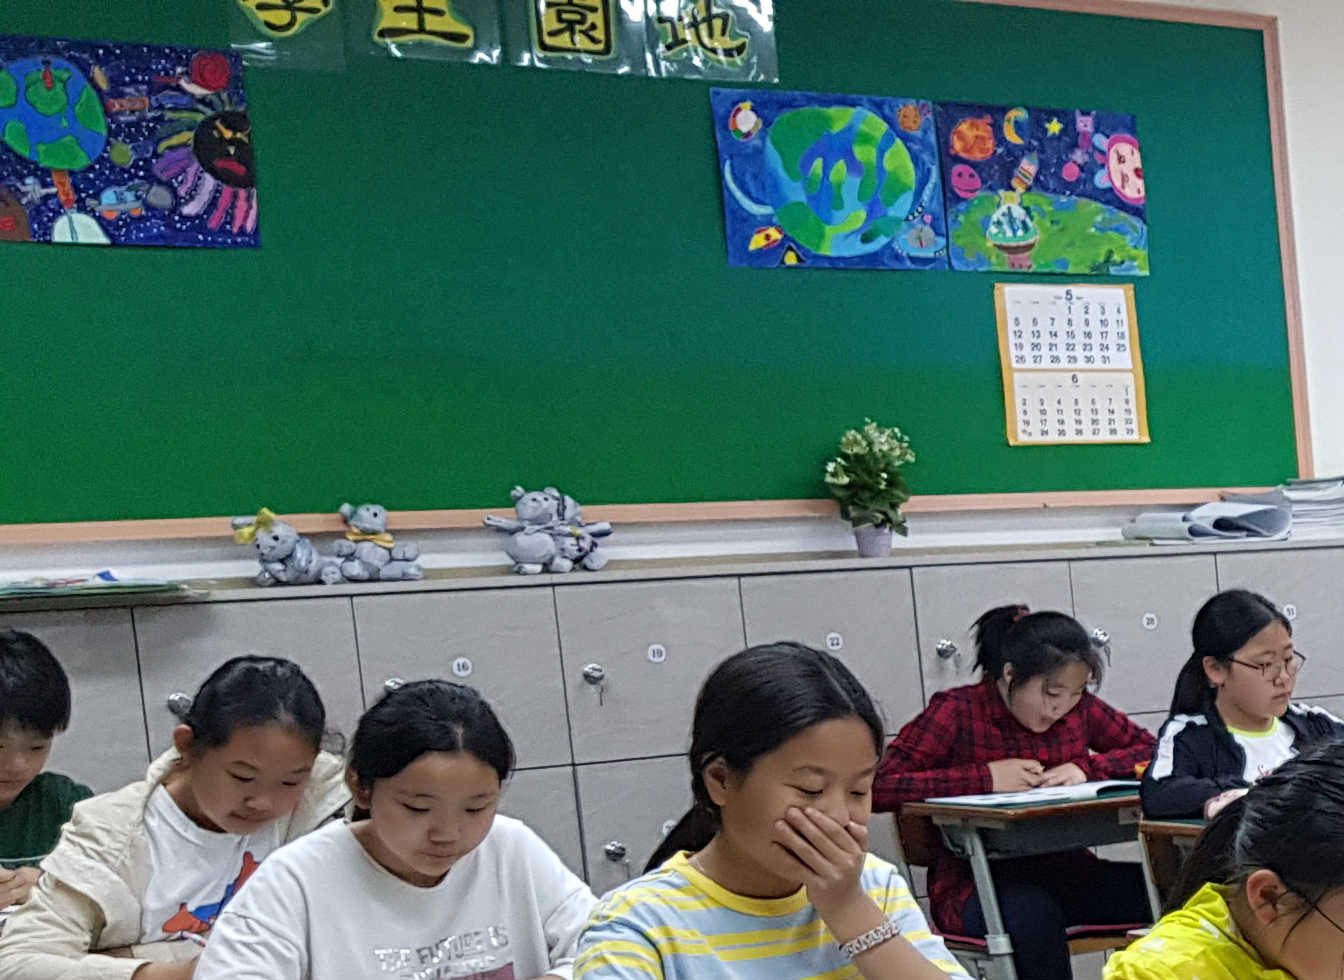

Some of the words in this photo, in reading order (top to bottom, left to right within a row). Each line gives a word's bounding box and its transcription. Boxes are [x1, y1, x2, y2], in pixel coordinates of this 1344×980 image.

[1065, 289, 1072, 301] 5
[1014, 317, 1020, 326] 5
[1032, 317, 1038, 326] 6
[1050, 317, 1055, 326] 7
[1067, 318, 1072, 327] 8
[1084, 318, 1090, 327] 9
[1100, 319, 1108, 328] 10
[1116, 319, 1123, 328] 11
[1013, 329, 1023, 339] 12
[1031, 330, 1041, 339] 13
[1049, 331, 1058, 339] 14
[1066, 331, 1075, 339] 15
[1083, 331, 1092, 340] 16
[1100, 331, 1108, 340] 17
[1117, 331, 1125, 340] 18
[1014, 342, 1024, 351] 19
[1031, 343, 1041, 351] 20
[1049, 343, 1058, 351] 21
[1066, 343, 1076, 351] 22
[1083, 343, 1093, 352] 23
[1100, 343, 1109, 352] 24
[1116, 343, 1126, 352] 25
[1015, 355, 1026, 364] 26
[1032, 355, 1042, 364] 27
[1050, 355, 1061, 364] 28
[1067, 355, 1077, 364] 29
[1084, 355, 1095, 364] 30
[1101, 355, 1110, 364] 31
[1071, 374, 1078, 384] 6
[652, 648, 663, 658] 19
